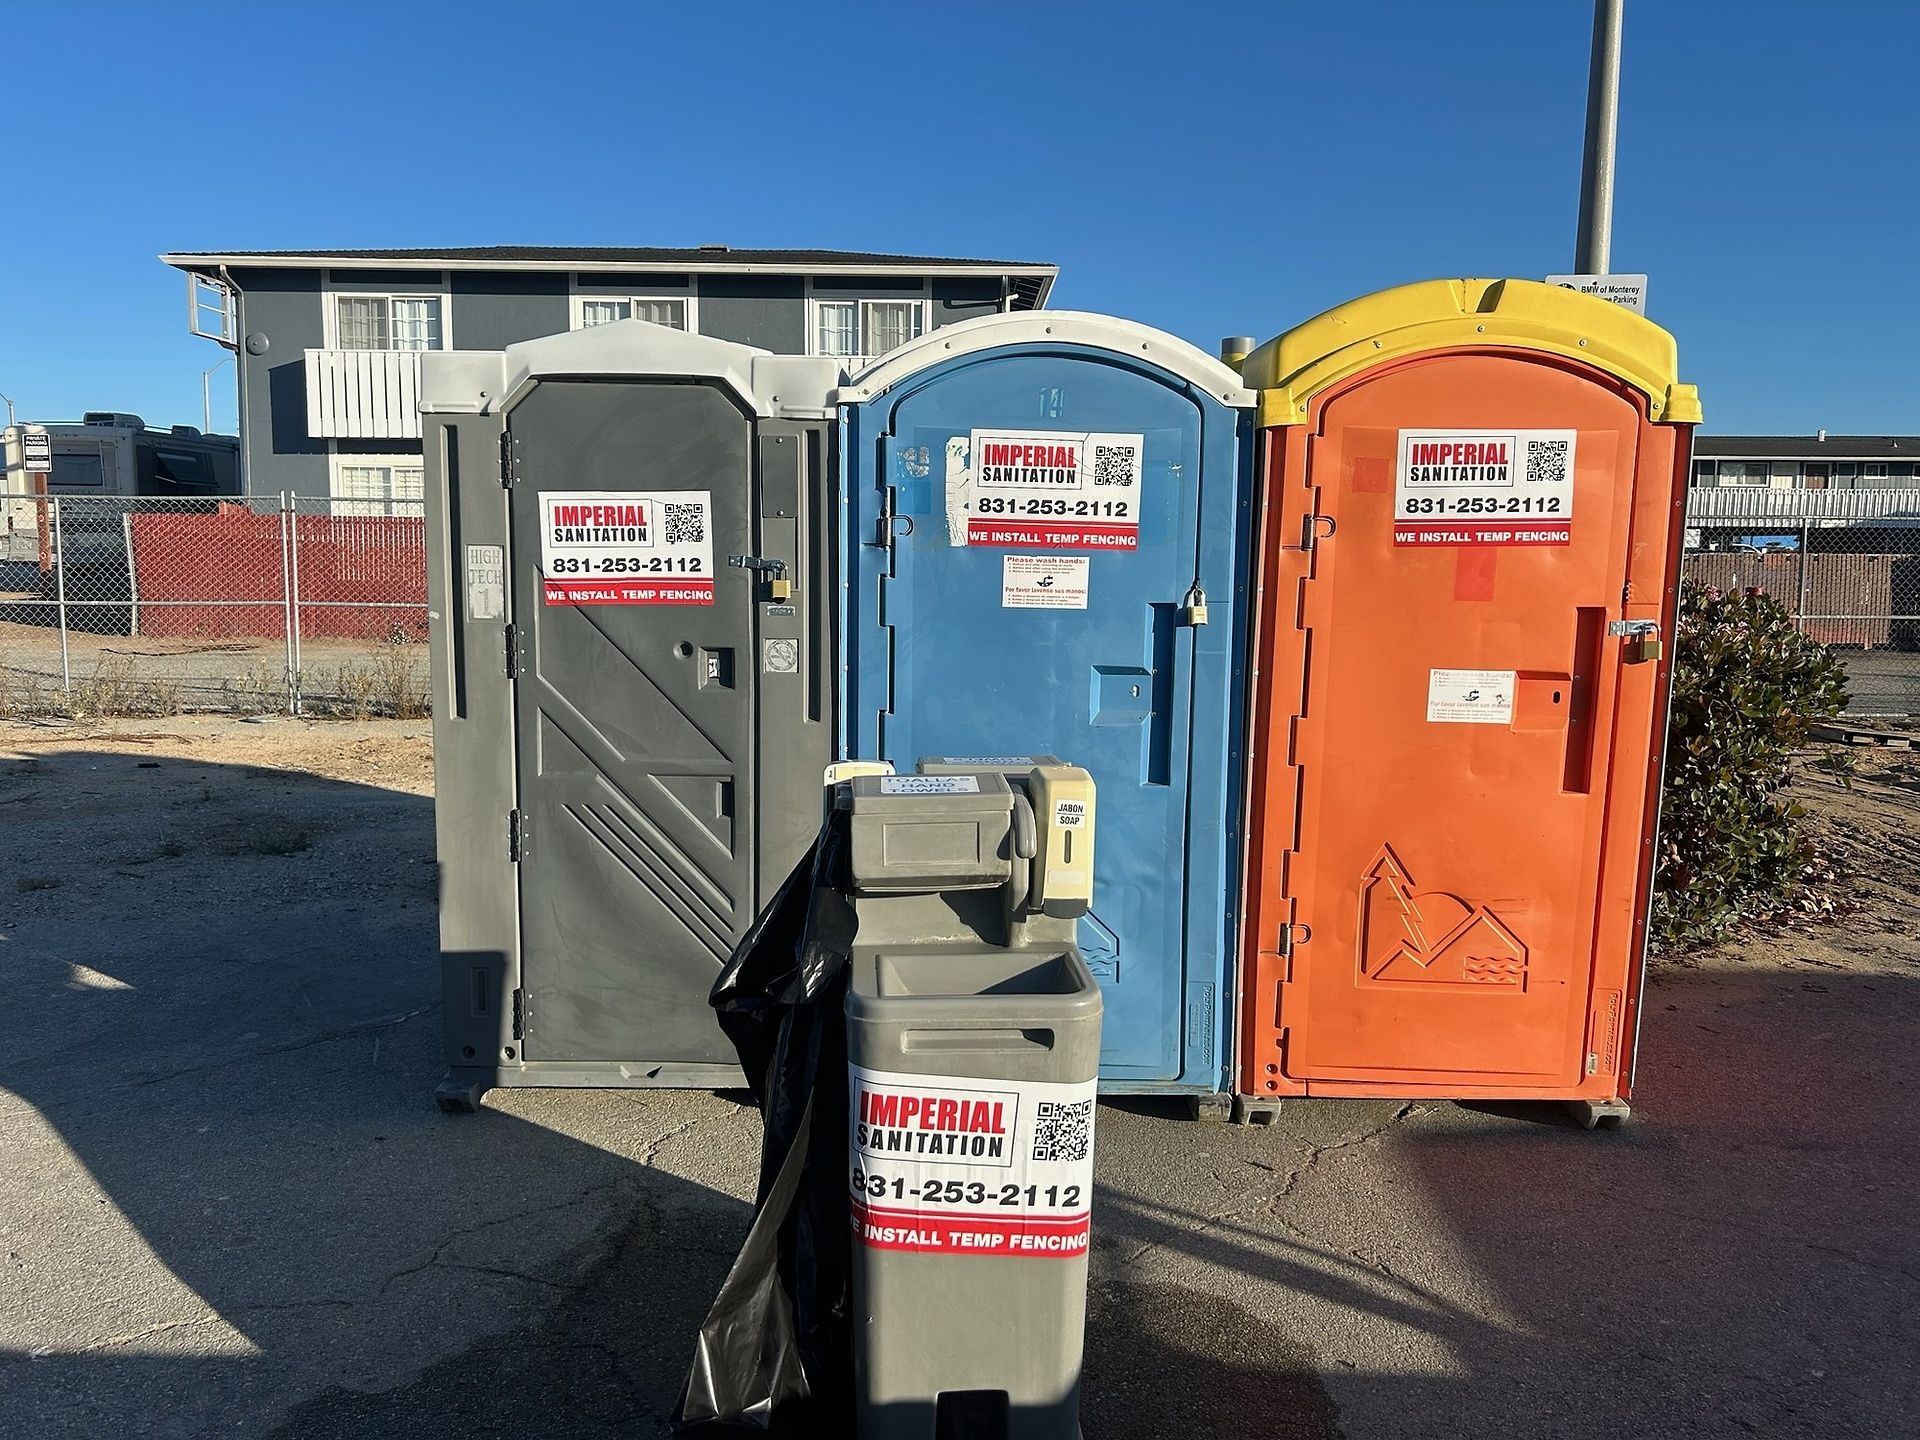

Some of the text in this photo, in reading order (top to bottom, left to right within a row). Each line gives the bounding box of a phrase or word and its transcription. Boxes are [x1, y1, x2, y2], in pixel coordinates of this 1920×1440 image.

[1608, 286, 1640, 294] Monterey
[1613, 296, 1637, 304] Parking
[984, 444, 1076, 468] IMPERIAL
[1412, 443, 1508, 465] IMPERIAL
[982, 467, 1076, 483] SANITATION
[1410, 466, 1507, 482] SANITATION
[978, 498, 1128, 517] 831-253-2112
[1406, 498, 1560, 513] 831-253-2112
[554, 506, 647, 527] IMPERIAL
[555, 528, 647, 542] SANITATION
[969, 531, 1136, 546] WE INSTALL TEMP FENCING
[1396, 531, 1569, 542] WE INSTALL TEMP FENCING
[470, 549, 500, 564] HIGH
[553, 558, 702, 573] 831-253-2112
[469, 570, 502, 585] TECH
[478, 588, 490, 615] 1
[546, 590, 712, 600] WE INSTALL TEMP FENCING
[1058, 803, 1084, 813] JABON
[1059, 815, 1080, 825] SOAP
[860, 1090, 1005, 1134] IMPERIAL
[857, 1123, 1003, 1158] SANITATION
[852, 1168, 1080, 1207] 831-253-2112
[864, 1224, 942, 1245] INSTALL
[949, 1232, 1004, 1248] TEMP
[1010, 1233, 1086, 1250] FENCING
